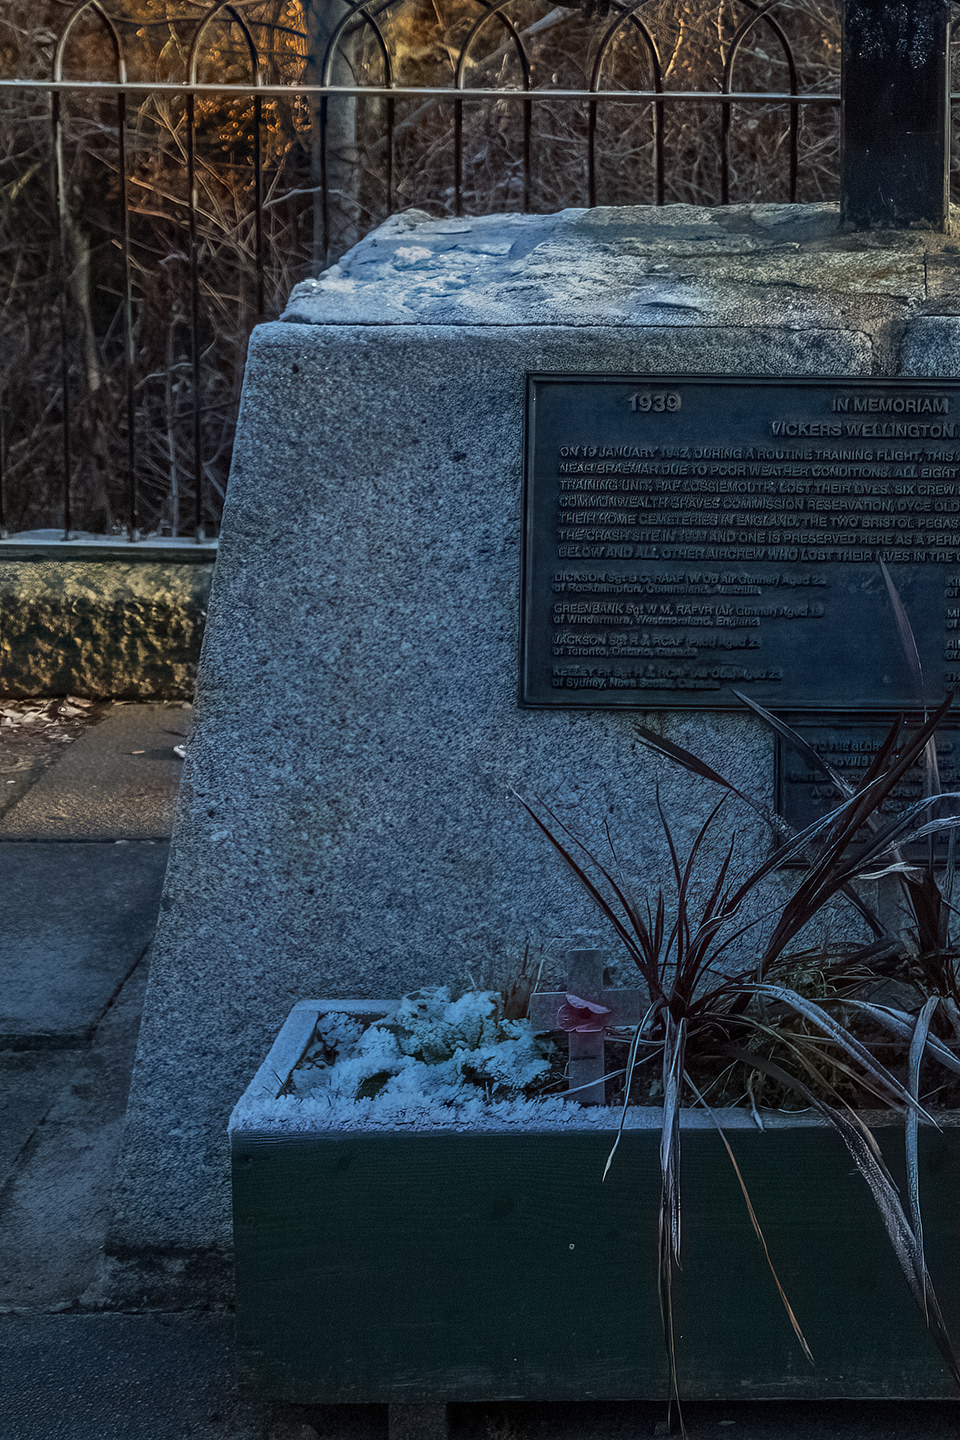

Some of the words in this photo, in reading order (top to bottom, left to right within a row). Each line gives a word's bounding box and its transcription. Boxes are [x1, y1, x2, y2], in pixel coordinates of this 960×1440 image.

[628, 393, 682, 413] 1939
[832, 398, 849, 413] IN
[853, 398, 949, 414] MEMORIAM
[771, 421, 842, 436] VICKERS
[847, 422, 956, 438] WELLINGTON
[560, 446, 578, 458] ON
[582, 446, 597, 458] 19
[600, 446, 658, 459] JANUARY
[694, 447, 742, 460] DURING
[747, 448, 757, 460] A
[760, 448, 812, 460] ROUTINE
[815, 449, 873, 461] TRAINING
[925, 450, 955, 461] THIS
[663, 464, 687, 475] DUE
[691, 464, 707, 476] TO
[711, 464, 745, 476] POOR
[749, 464, 808, 477] WEATHER
[895, 466, 918, 478] ALL
[921, 466, 959, 478] EIGHT
[560, 478, 618, 492] TRAINING
[657, 479, 682, 492] RAF
[780, 481, 811, 493] LOST
[814, 481, 850, 494] THEIR
[895, 482, 915, 494] SIX
[918, 482, 955, 495] CREW
[723, 497, 803, 510] COMMISSION
[898, 499, 931, 511] DYCE
[934, 499, 960, 512] OLD
[560, 512, 595, 524] THEIR
[598, 512, 636, 525] HOME
[720, 514, 734, 526] IN
[801, 515, 827, 527] THE
[829, 515, 859, 527] TWO
[862, 516, 915, 528] BRISTOL
[560, 528, 585, 541] THE
[587, 528, 628, 541] CRASH
[632, 529, 661, 541] SITE
[663, 529, 675, 541] IN
[710, 530, 735, 542] AND
[738, 530, 766, 542] ONE
[768, 531, 780, 543] IS
[783, 531, 857, 543] PRESERVED
[860, 532, 893, 544] HERE
[895, 533, 912, 544] AS
[916, 533, 925, 544] A
[559, 545, 604, 558] BELOW
[606, 546, 633, 559] AND
[637, 546, 659, 559] ALL
[661, 547, 703, 559] OTHER
[706, 547, 765, 560] AIRCREW
[767, 548, 798, 560] WHO
[838, 549, 872, 561] THEIR
[913, 550, 926, 561] IN
[930, 550, 955, 561] THE
